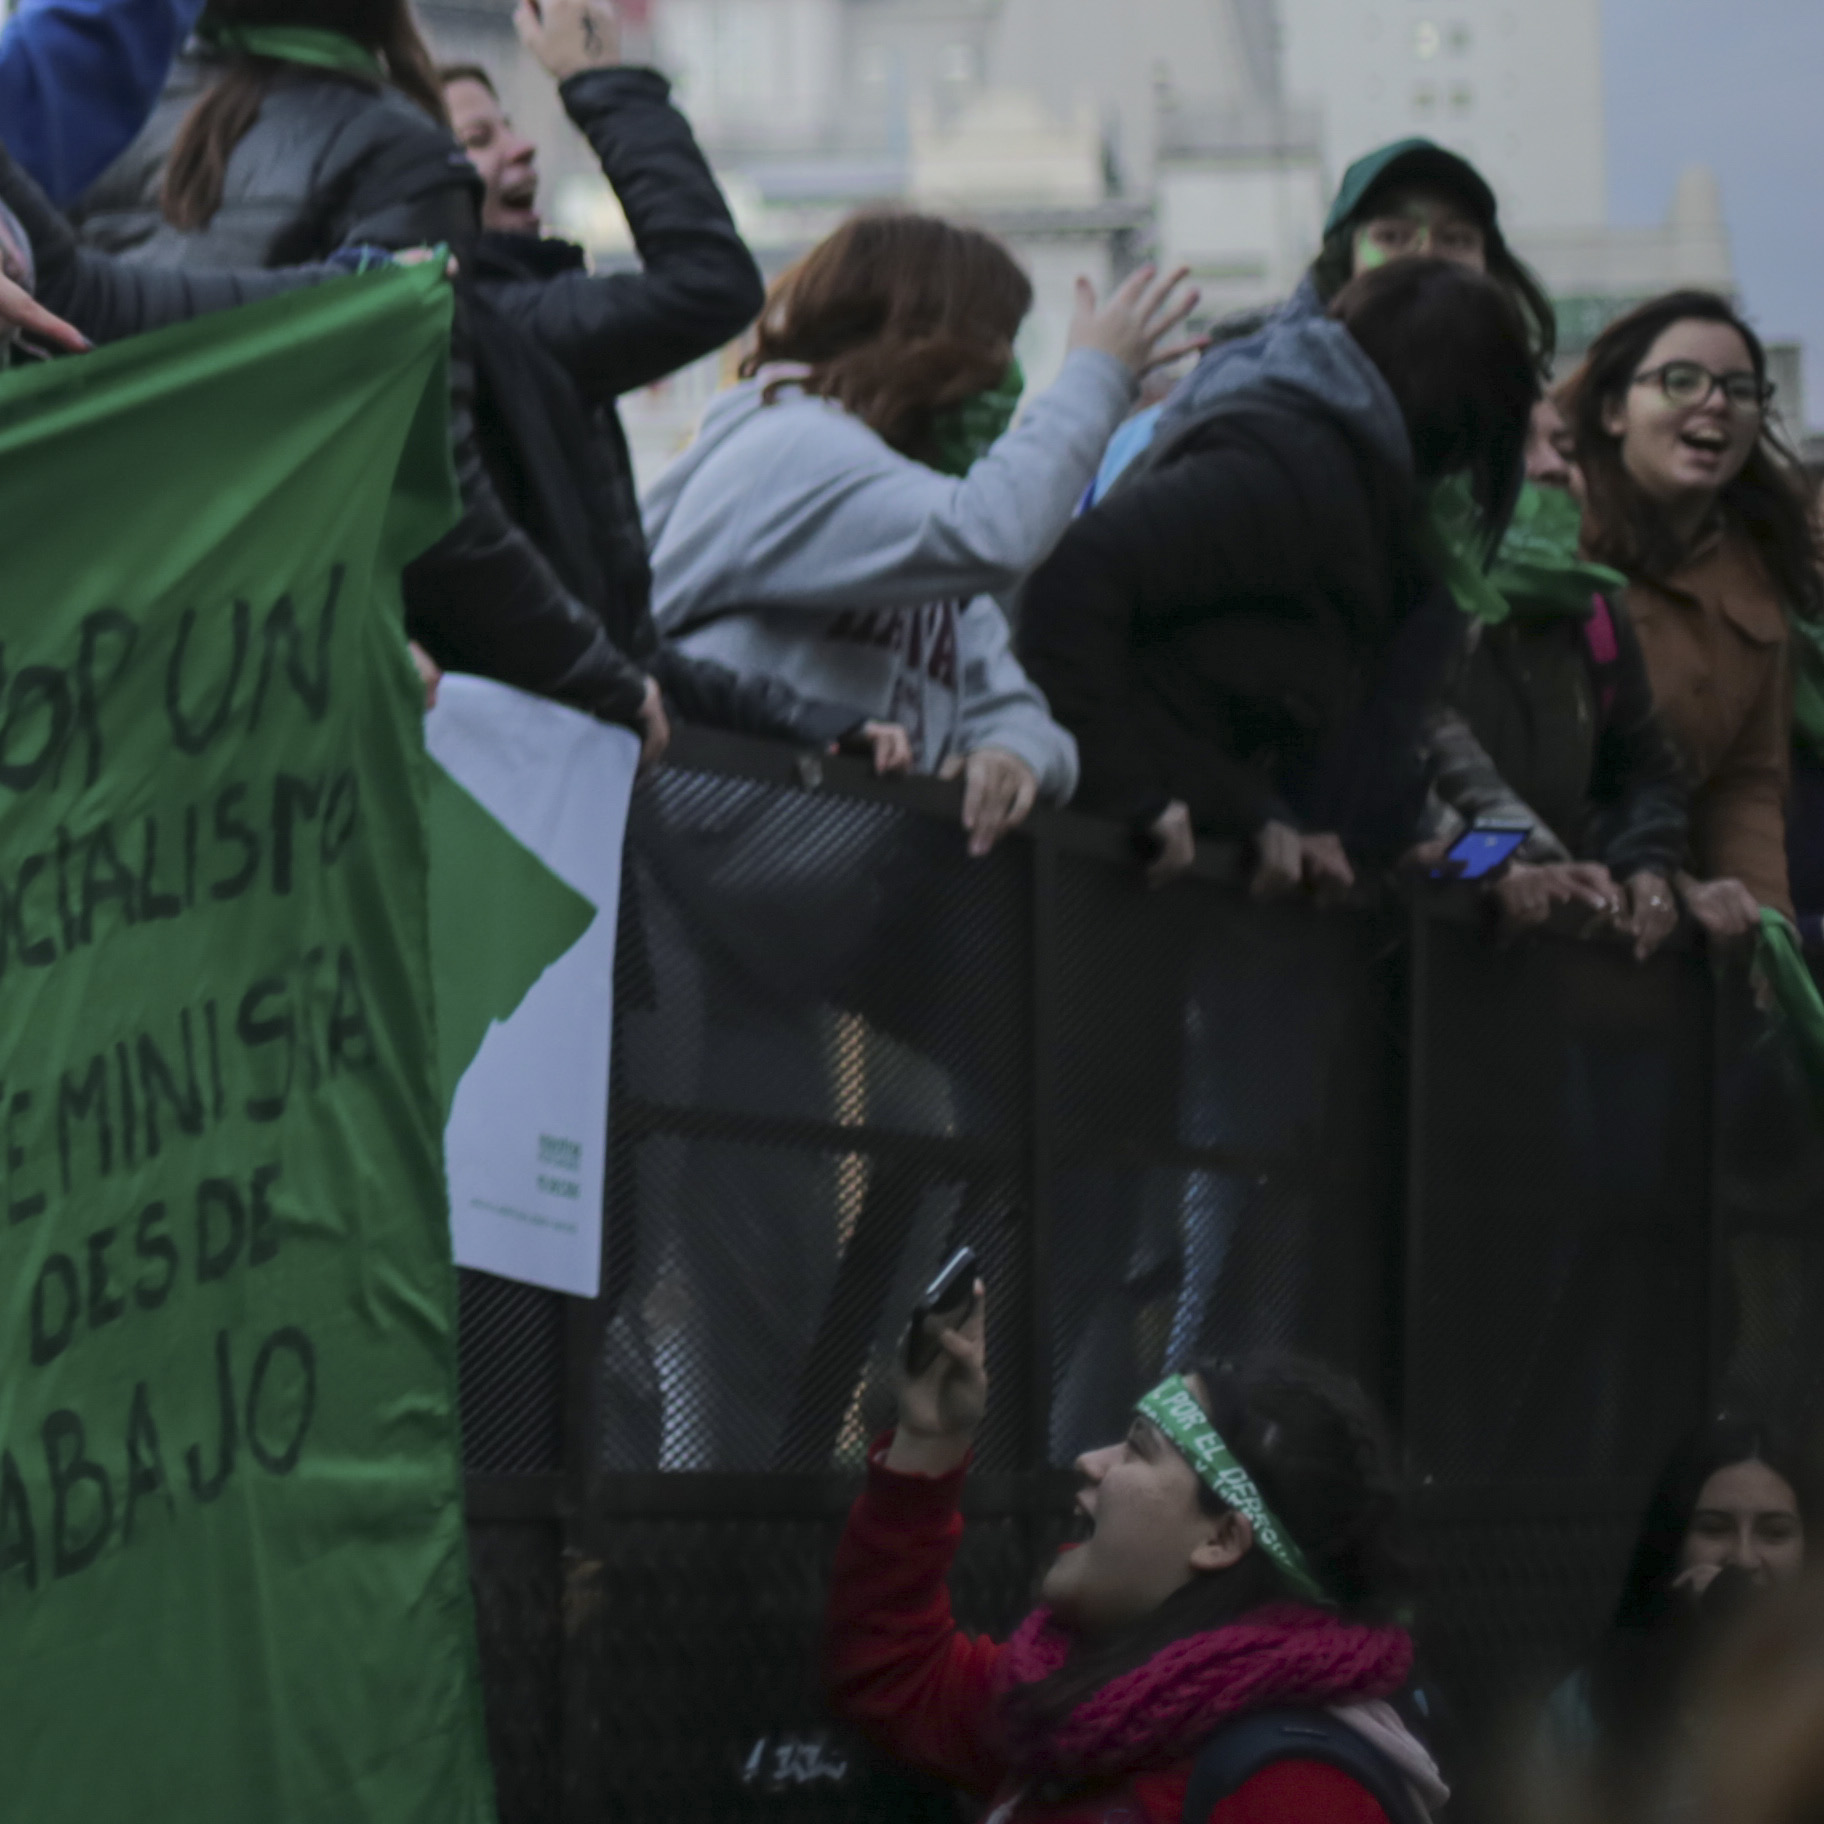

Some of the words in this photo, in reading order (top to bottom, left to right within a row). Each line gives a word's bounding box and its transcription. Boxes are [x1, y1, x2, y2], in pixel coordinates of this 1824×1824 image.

[165, 562, 347, 756] UN
[30, 1161, 284, 1368] DESDE
[1163, 1390, 1207, 1431] POR
[1194, 1431, 1226, 1462] EL
